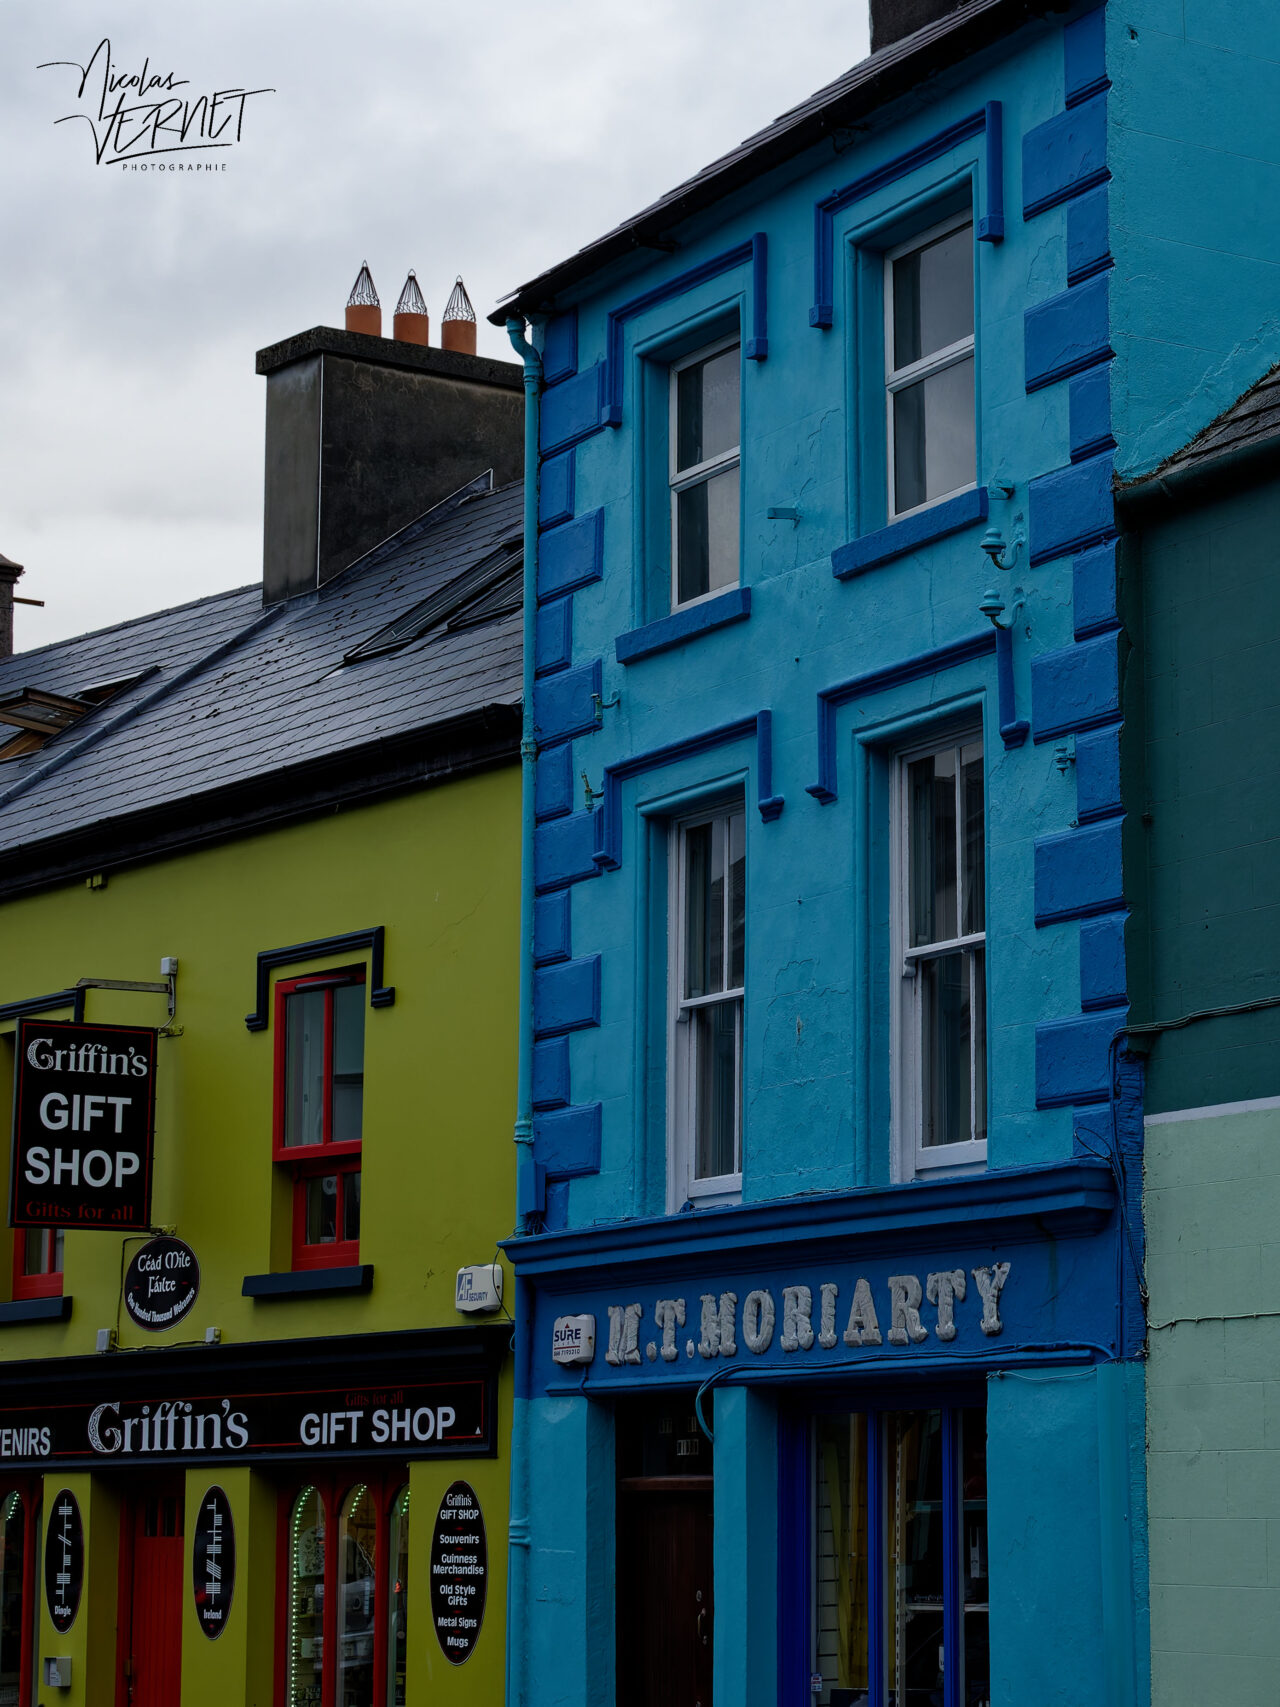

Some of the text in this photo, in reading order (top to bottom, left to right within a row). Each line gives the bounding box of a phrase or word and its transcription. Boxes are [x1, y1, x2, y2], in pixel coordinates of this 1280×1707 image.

[26, 1037, 149, 1078] Griffin's
[39, 1092, 133, 1134] GIFT
[24, 1146, 140, 1188] SHOP
[26, 1200, 134, 1221] Gifts for all
[554, 1328, 581, 1343] SURE
[87, 1398, 249, 1454] Griffin's
[300, 1406, 456, 1446] GIFT SHOP
[0, 1426, 51, 1457] ENIRS
[446, 1493, 473, 1507] Griffin's
[440, 1509, 480, 1520] GIFT SHOP
[439, 1534, 480, 1544] Souvenirs
[441, 1553, 478, 1563] Guinness
[433, 1564, 484, 1575] Merchandise
[440, 1585, 476, 1596] Old Style
[448, 1595, 468, 1606] Gifts
[55, 1605, 72, 1617] Dingle
[203, 1609, 222, 1619] Ireland
[438, 1616, 478, 1629] Metal Signs
[447, 1636, 469, 1648] Mugs
